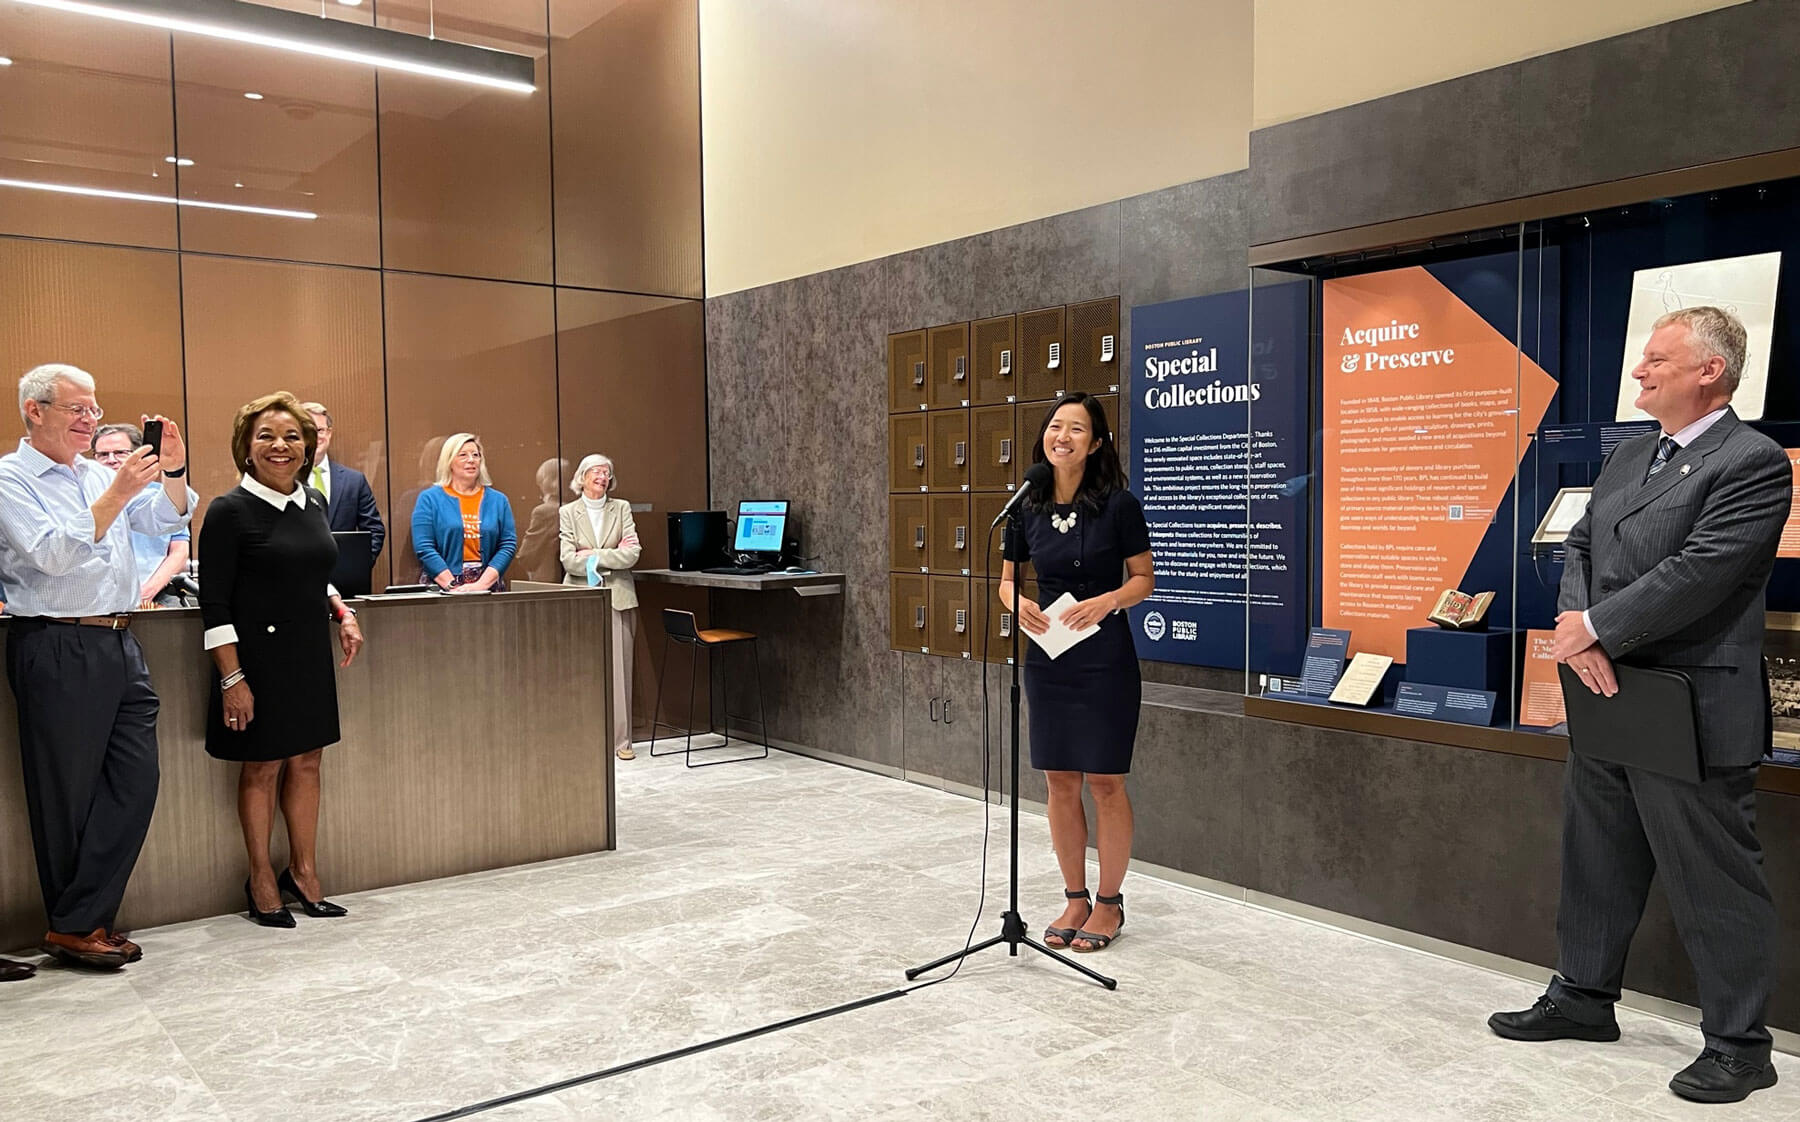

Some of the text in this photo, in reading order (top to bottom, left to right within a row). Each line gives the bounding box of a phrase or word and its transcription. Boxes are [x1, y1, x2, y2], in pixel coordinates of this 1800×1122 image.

[1340, 320, 1420, 346] Acquire
[1145, 348, 1217, 382] Special
[1340, 348, 1454, 372] & Preserve
[1144, 380, 1260, 409] Collections
[1415, 392, 1433, 401] Library
[1178, 434, 1195, 443] Special
[1222, 431, 1253, 440] Departmen.
[1254, 482, 1286, 490] preservation
[1172, 626, 1197, 634] PUBLIC
